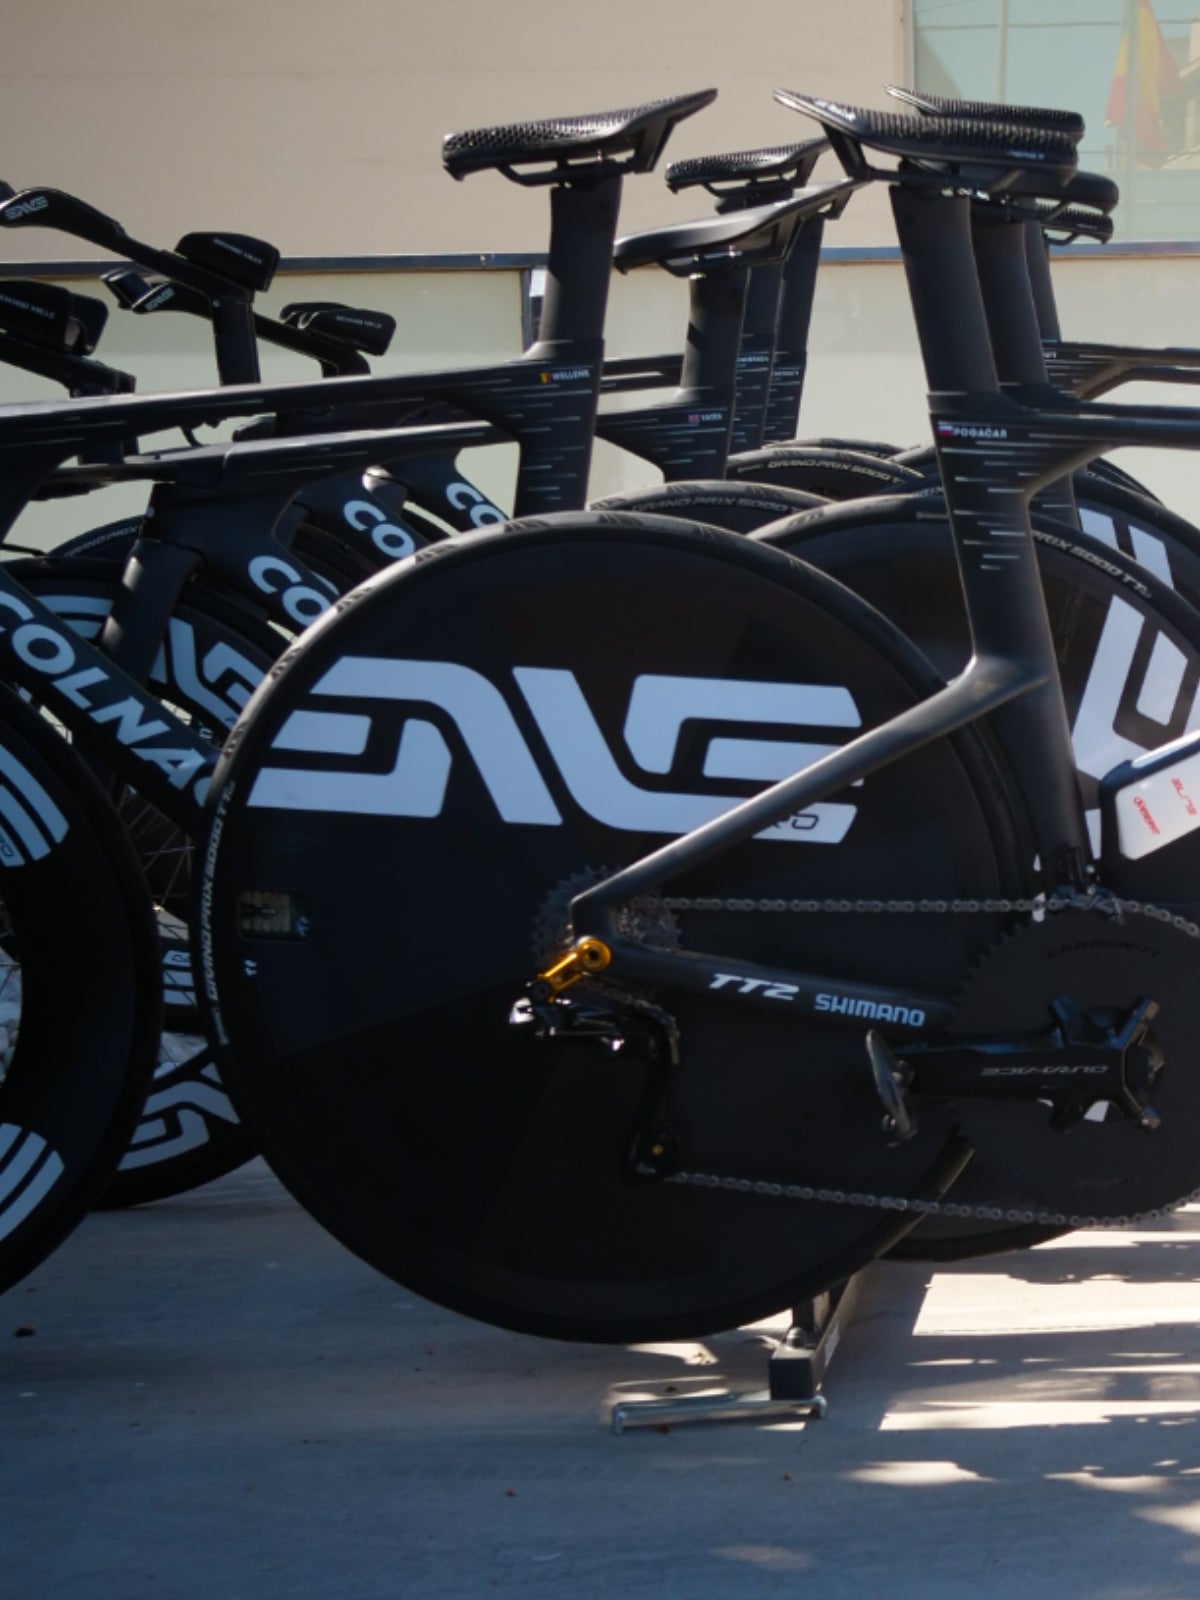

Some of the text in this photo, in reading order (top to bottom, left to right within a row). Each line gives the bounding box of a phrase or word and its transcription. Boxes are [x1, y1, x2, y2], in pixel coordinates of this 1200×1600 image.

[552, 368, 590, 380] WELLENS
[0, 589, 212, 807] OLNA
[246, 655, 863, 844] ENVE
[813, 992, 927, 1029] SHIMANO
[980, 1064, 1109, 1077] DURA-ACE
